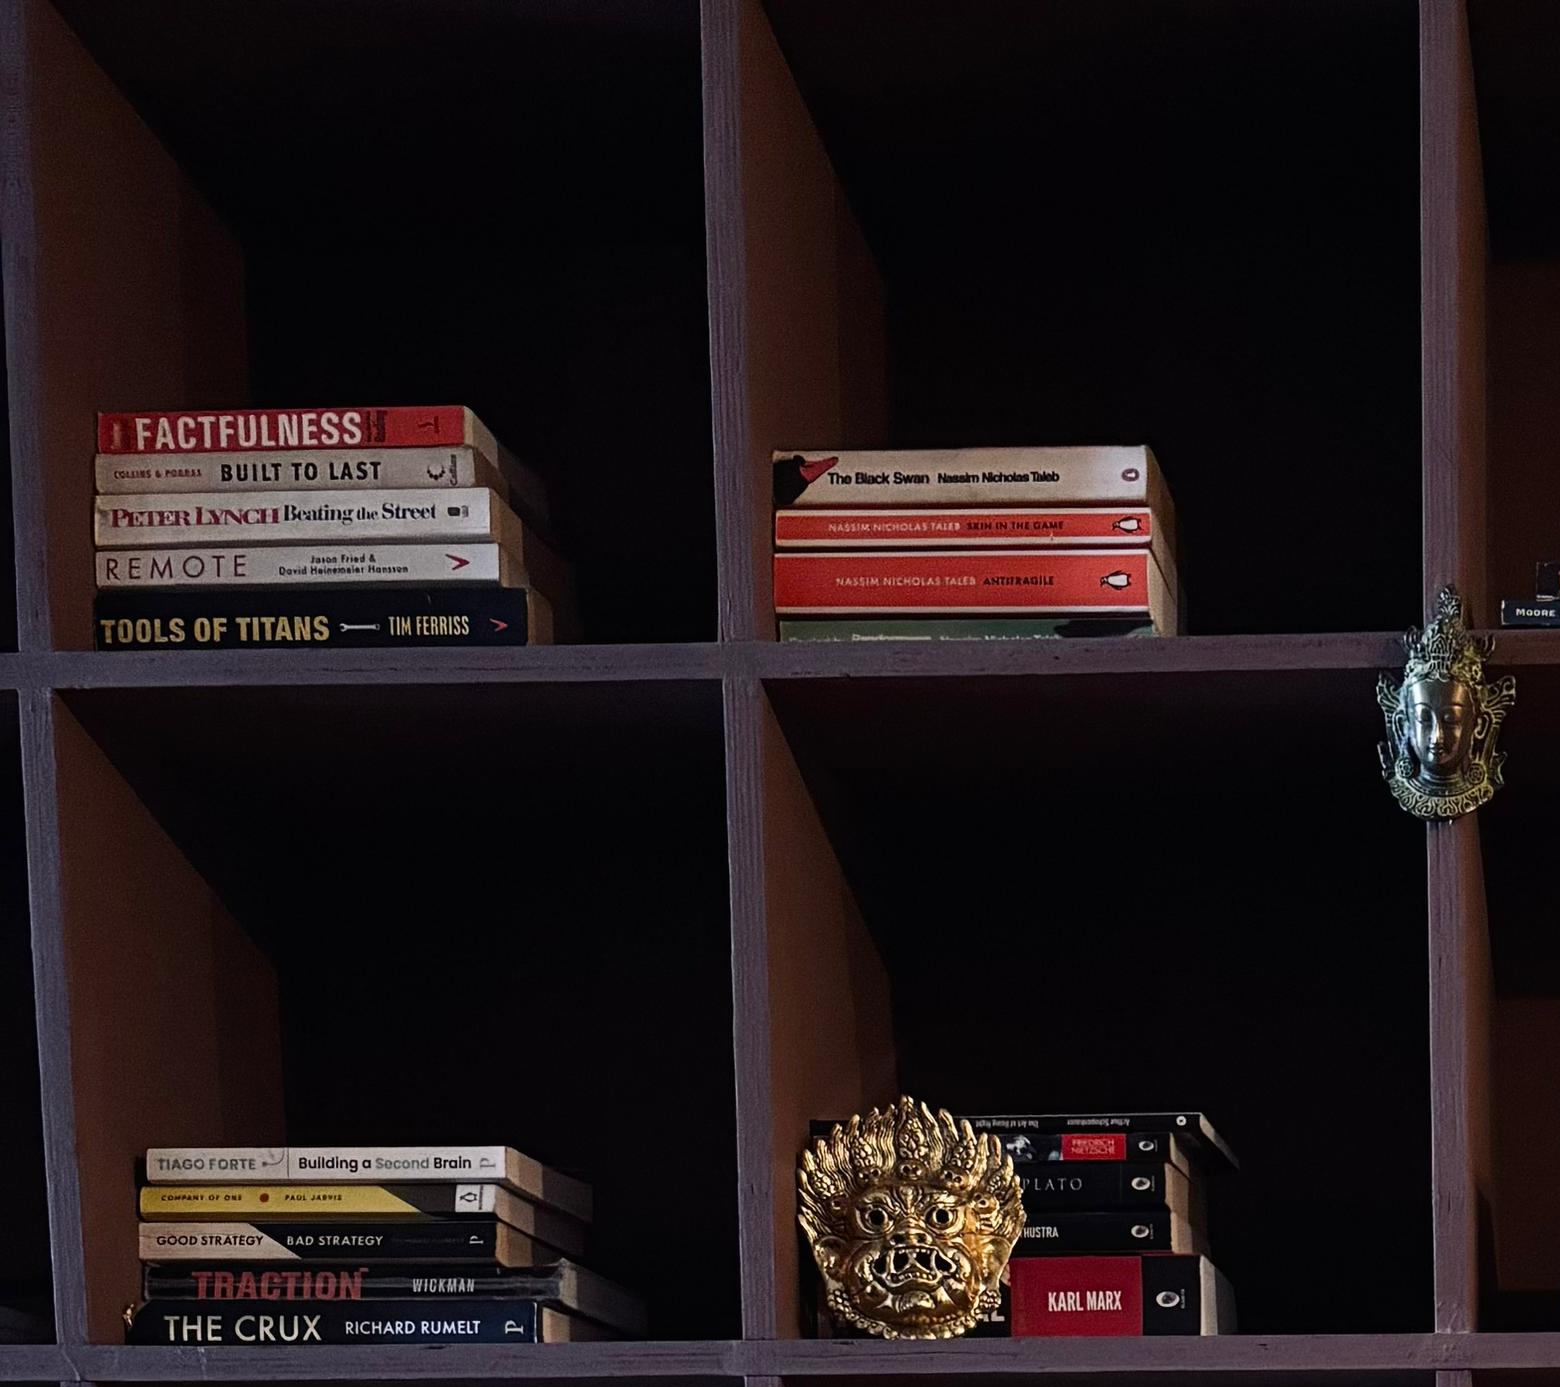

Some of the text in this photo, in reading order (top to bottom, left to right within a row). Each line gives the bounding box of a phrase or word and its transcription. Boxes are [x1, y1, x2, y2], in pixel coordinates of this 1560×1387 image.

[135, 412, 361, 448] FACTFULNESS
[221, 462, 381, 482] BUILT TO LAST
[828, 472, 929, 484] The Black Swan
[938, 471, 1059, 483] Nassim Nicholas Taleb
[110, 508, 279, 528] PETER LYNCH
[284, 502, 436, 525] Beating the Street
[105, 555, 248, 580] REMOTE
[101, 615, 329, 643] TOOLS OF TITANS
[388, 615, 469, 636] TIM FERRISS
[157, 1157, 256, 1171] TIAGO FORTE
[299, 1155, 471, 1172] Building a Second Brain
[1022, 1178, 1082, 1191] PLATO
[157, 1235, 263, 1247] GOOD STRATEGY
[287, 1235, 382, 1246] BAD STRATEGY
[192, 1268, 369, 1300] TRACTION
[413, 1278, 475, 1293] WICKMAN
[1049, 1291, 1122, 1311] KARL MARX
[164, 1314, 321, 1342] THE CRUX
[345, 1320, 480, 1335] RICHARD RUMELT
